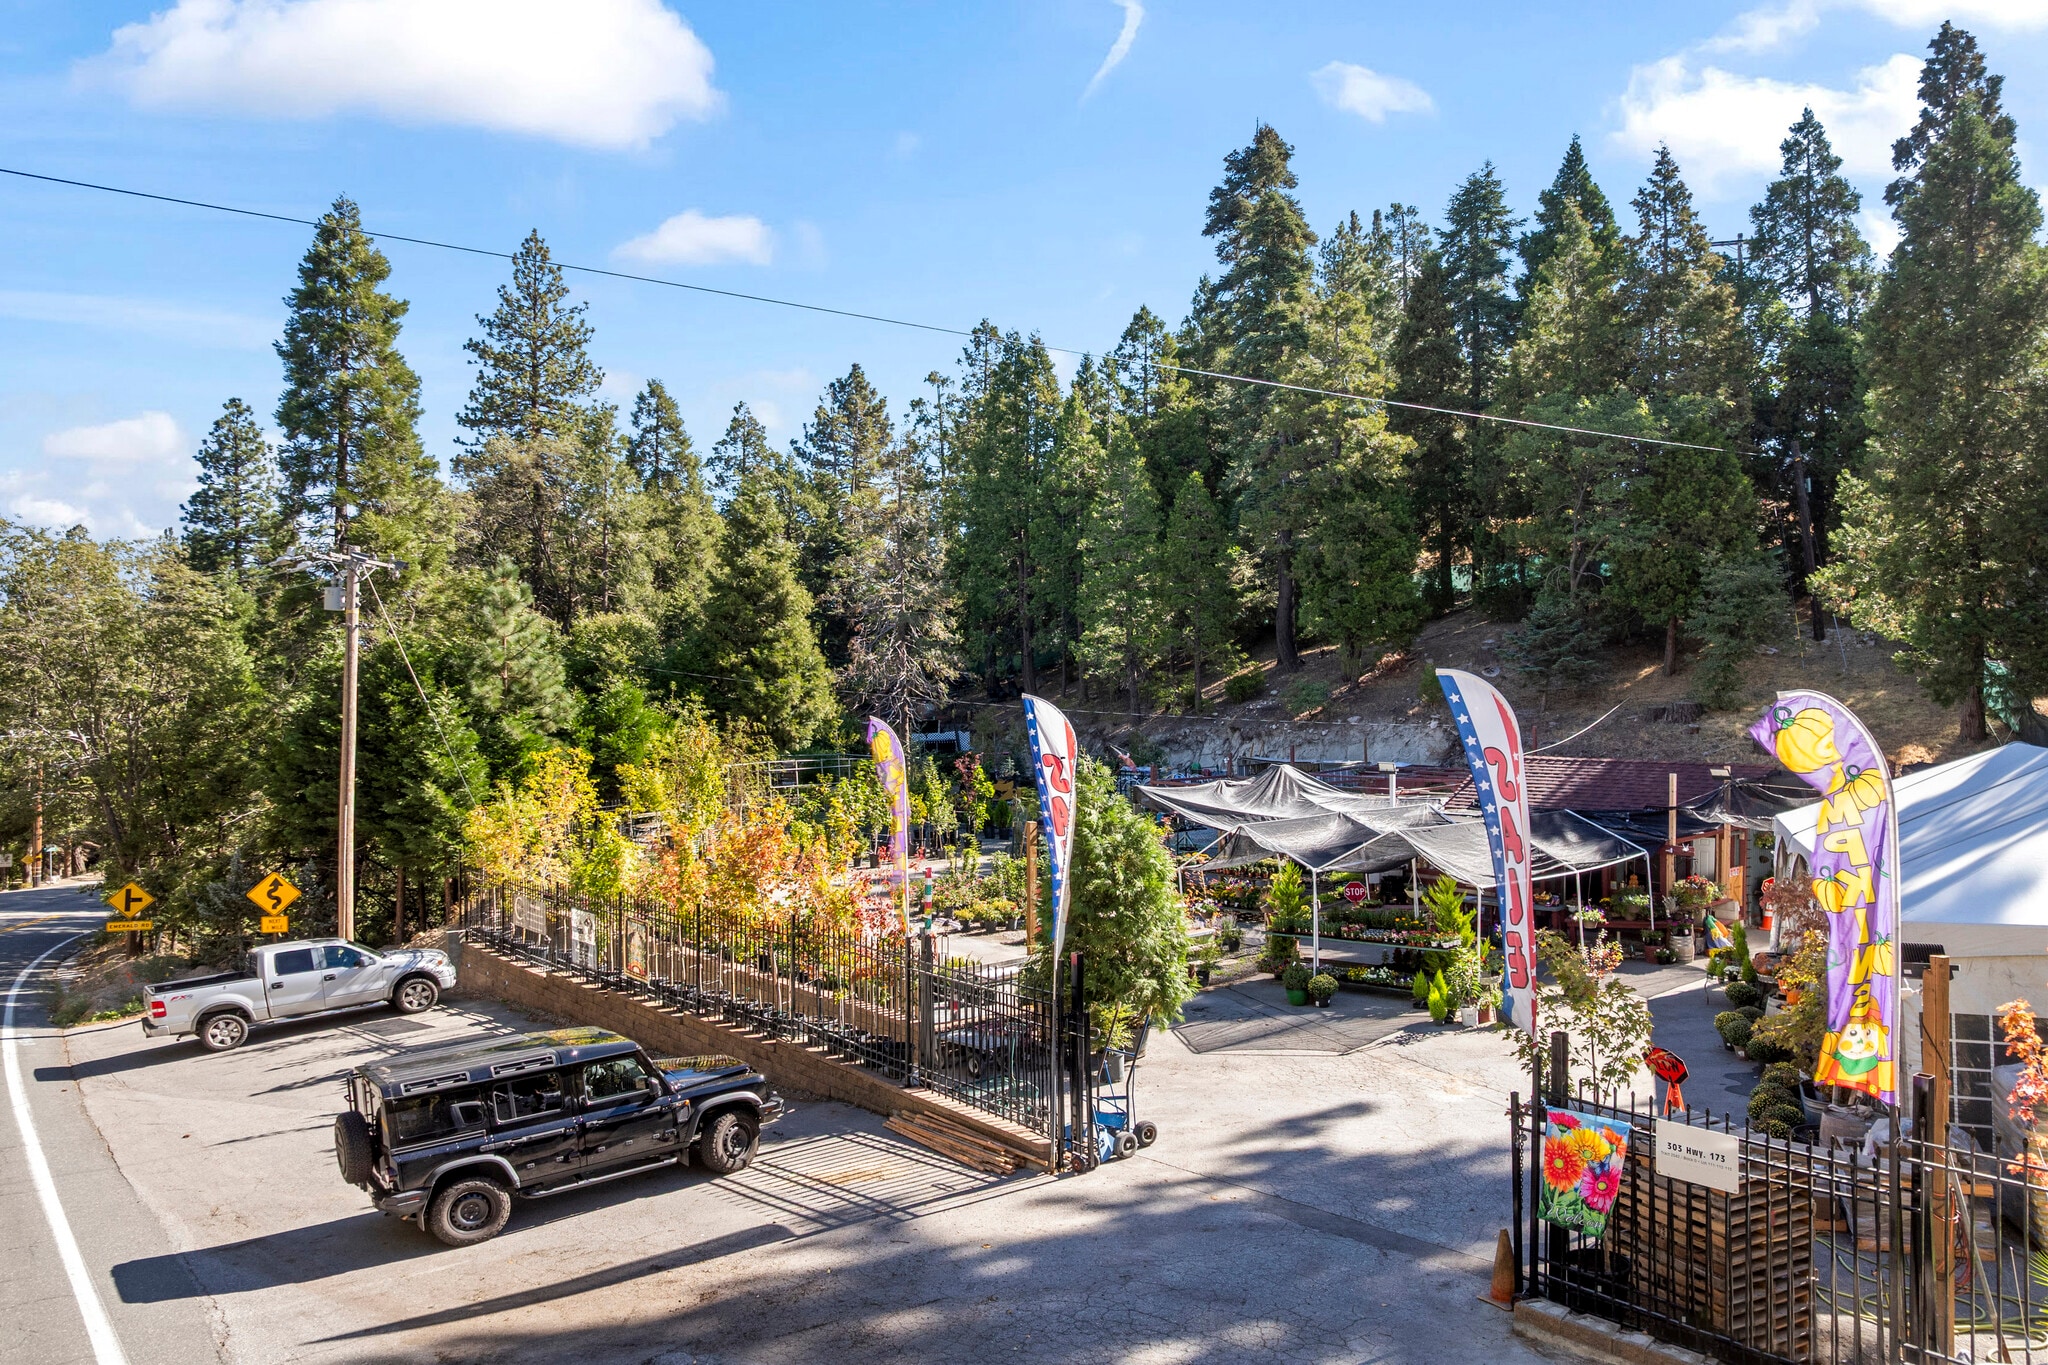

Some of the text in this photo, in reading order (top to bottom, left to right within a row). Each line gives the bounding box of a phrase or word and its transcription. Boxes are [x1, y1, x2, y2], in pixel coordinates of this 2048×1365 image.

[1345, 887, 1365, 896] STOP
[170, 994, 194, 1002] FX4
[1667, 1141, 1683, 1153] 303
[1709, 1152, 1726, 1163] 173
[1547, 1201, 1604, 1229] Welcom
